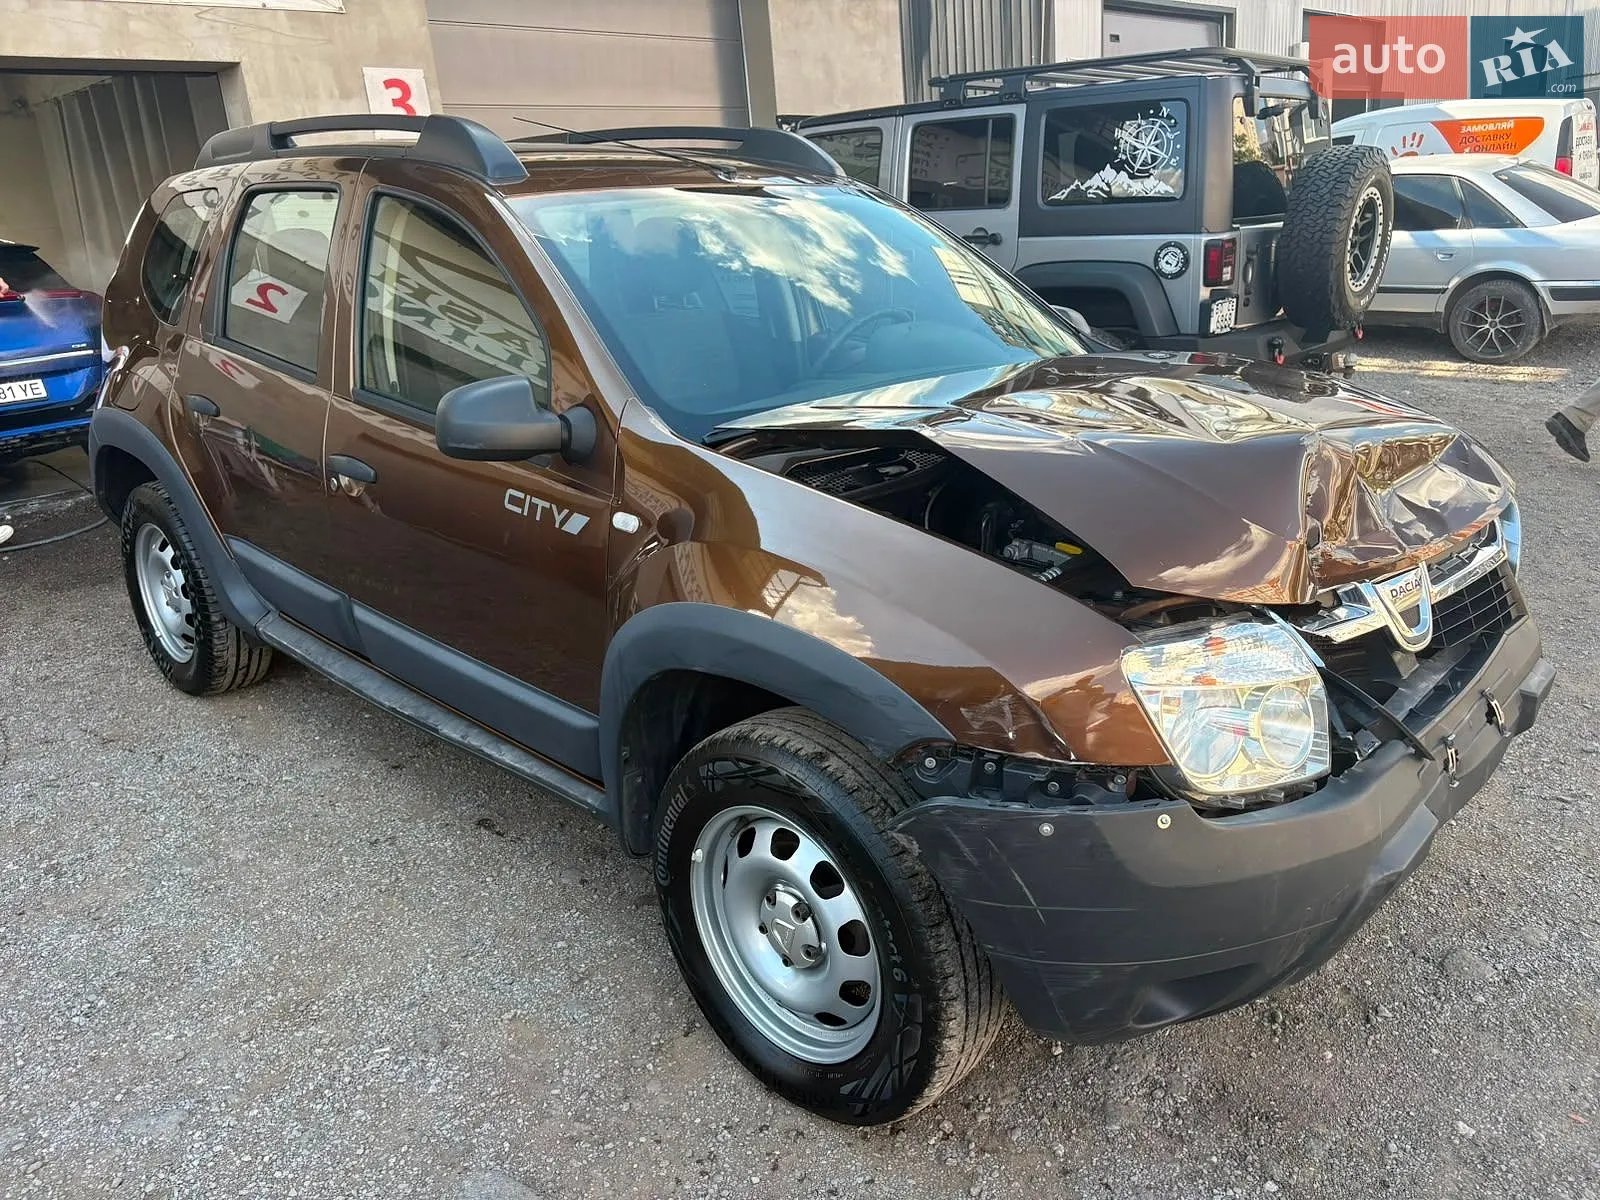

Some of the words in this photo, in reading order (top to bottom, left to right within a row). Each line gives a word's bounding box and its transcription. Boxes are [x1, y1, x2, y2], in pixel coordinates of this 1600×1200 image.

[383, 78, 416, 117] 3
[19, 382, 42, 397] YE
[504, 487, 570, 529] CITY
[1390, 578, 1422, 599] DACIA
[656, 783, 689, 887] Continental
